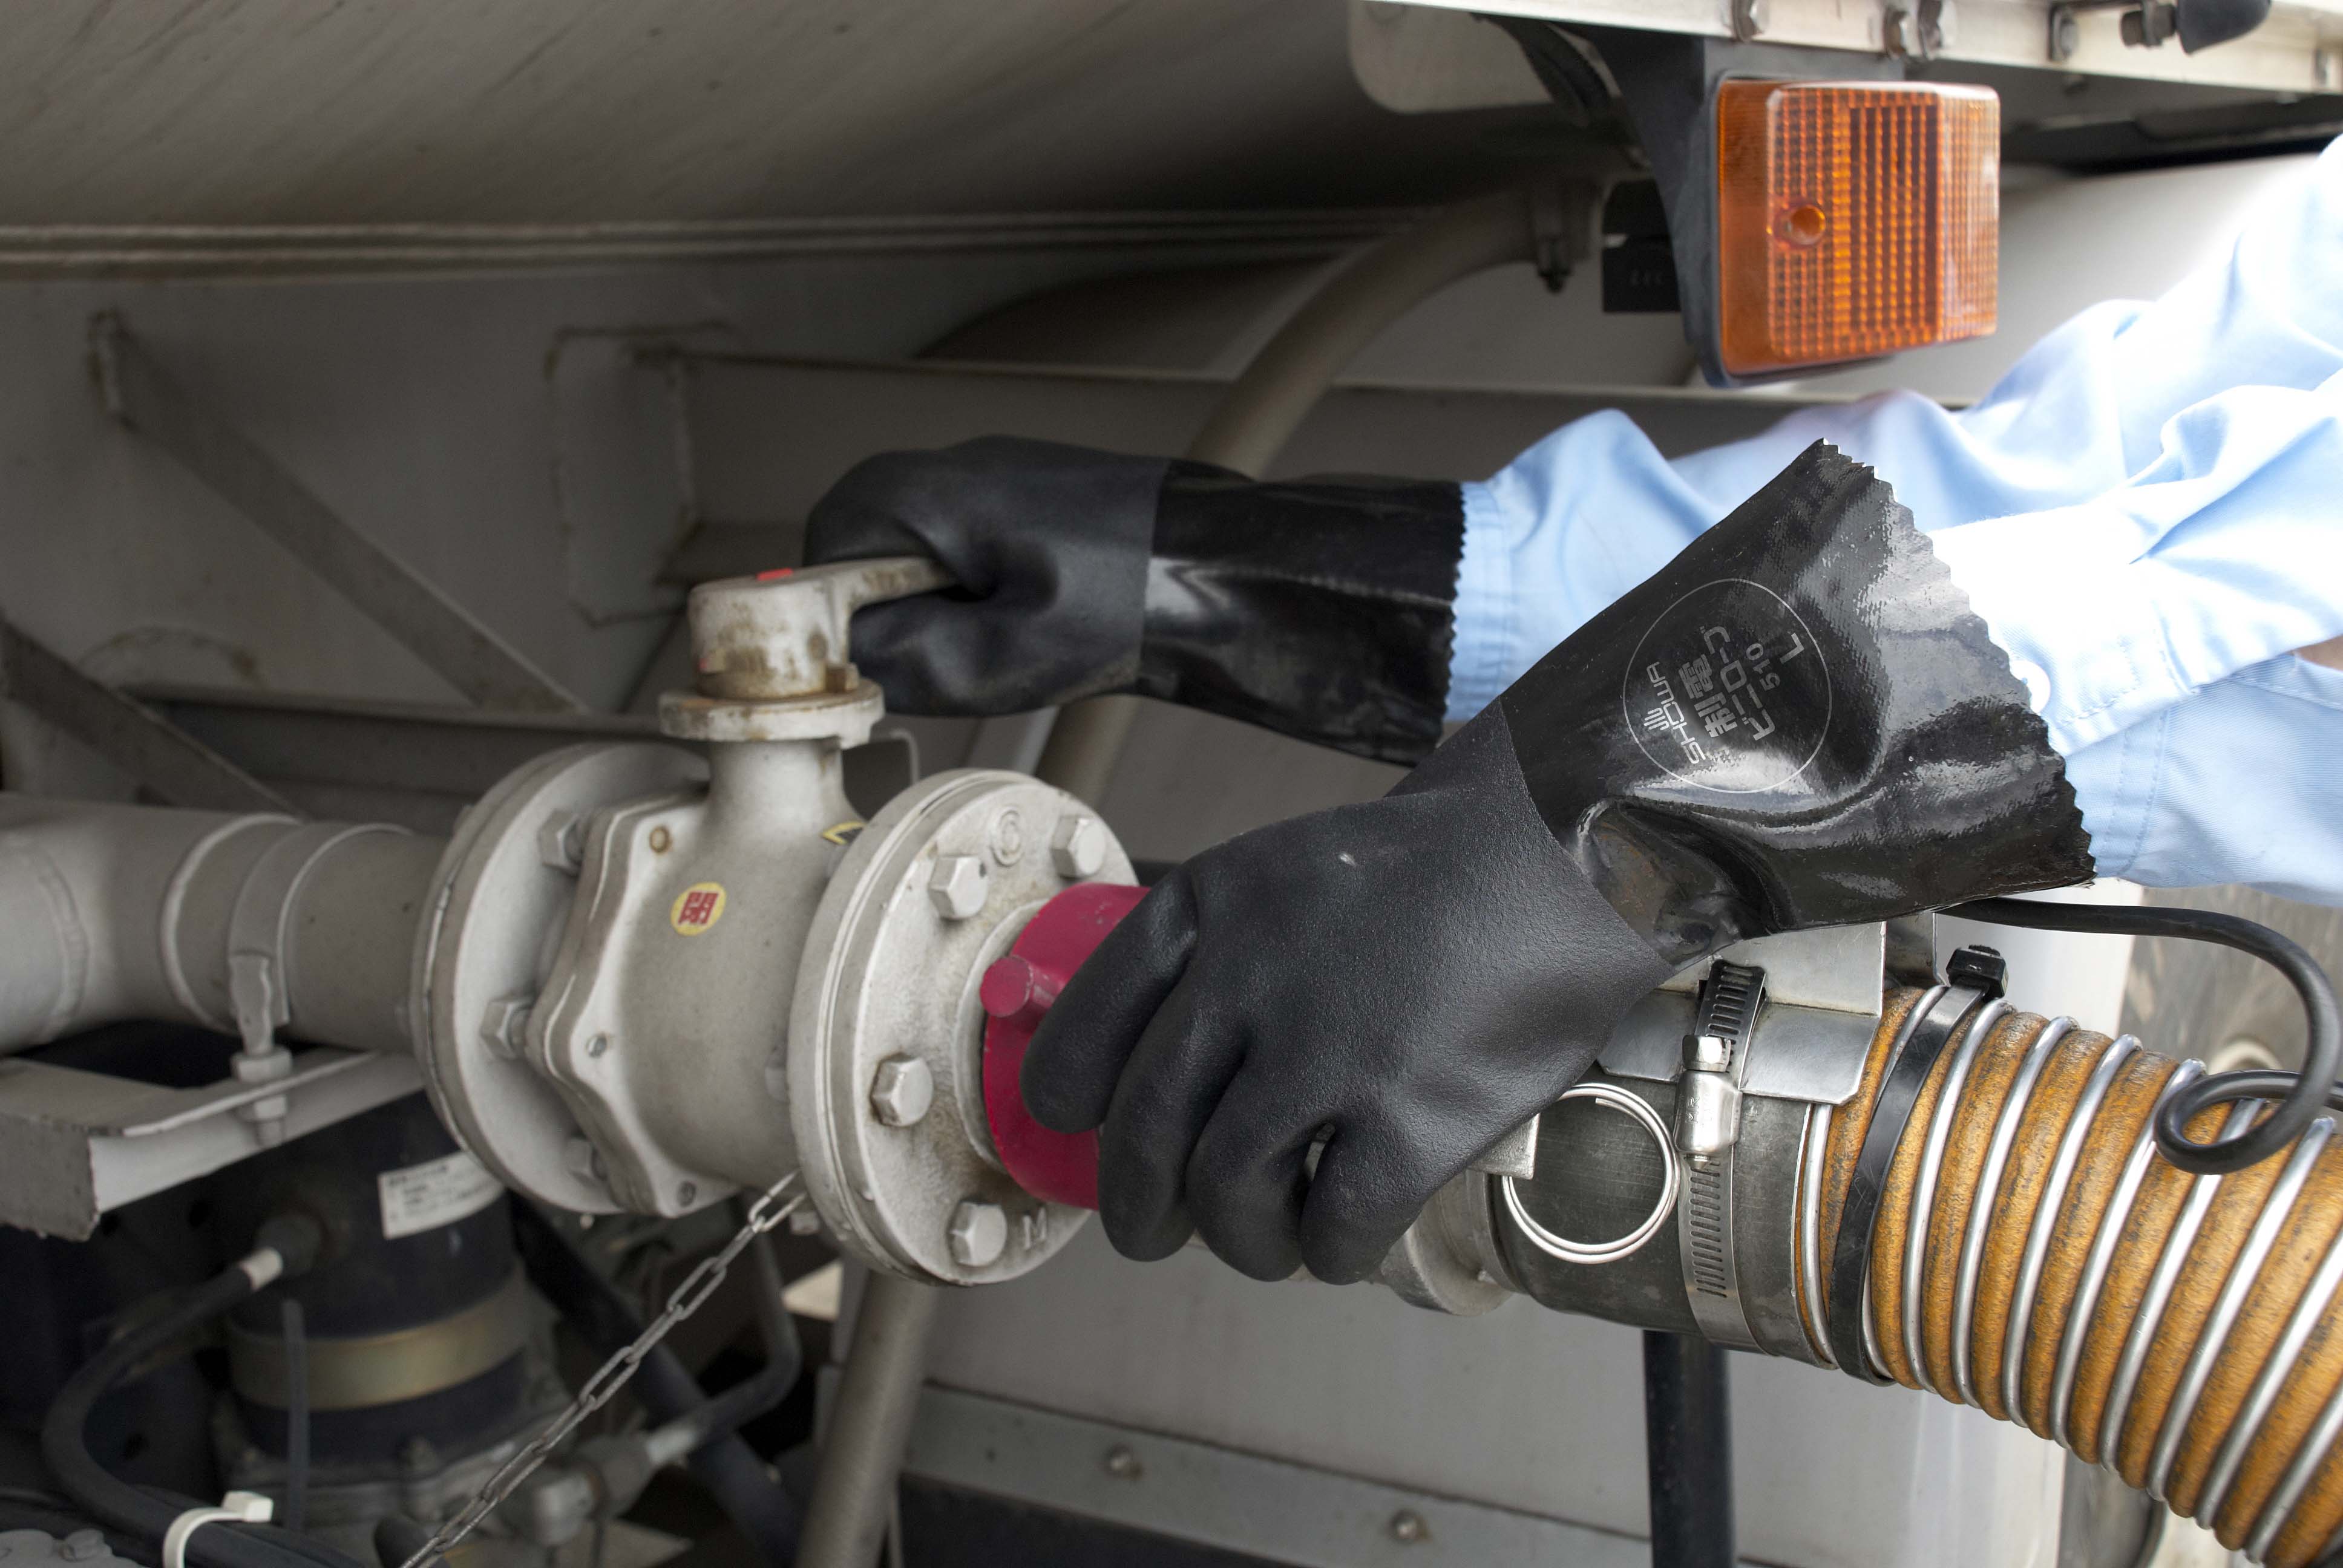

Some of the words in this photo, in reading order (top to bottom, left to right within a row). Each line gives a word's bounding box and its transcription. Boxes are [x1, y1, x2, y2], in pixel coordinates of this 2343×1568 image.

[1746, 642, 1781, 691] 510
[1780, 633, 1804, 664] L
[1646, 661, 1706, 764] SHOWA
[1679, 654, 1738, 737] 制電
[1700, 626, 1775, 740] ビニローブ
[678, 891, 718, 924] 閉
